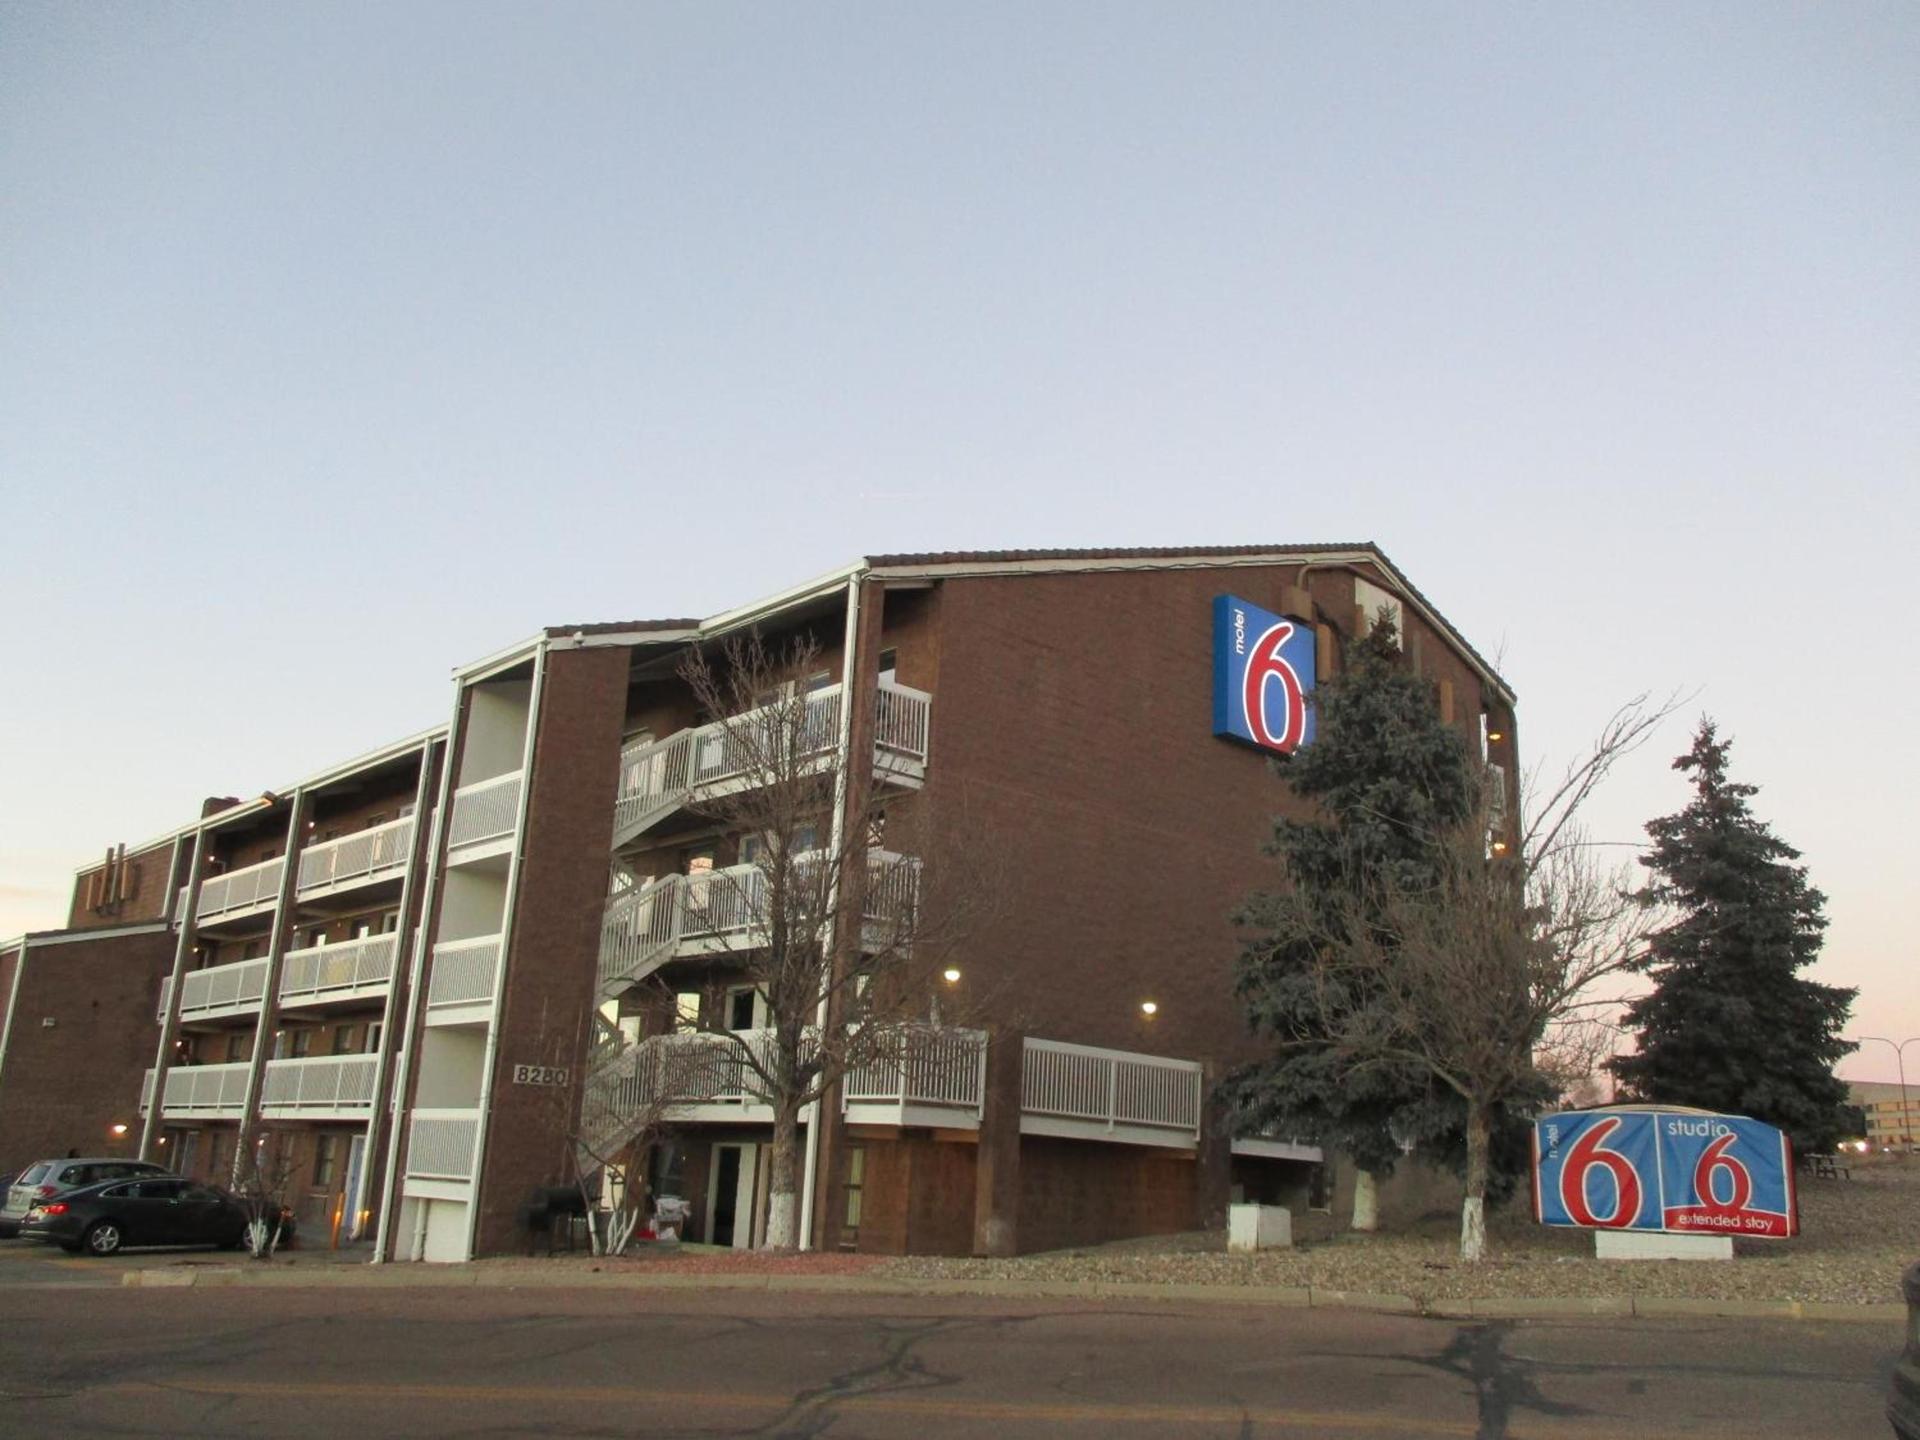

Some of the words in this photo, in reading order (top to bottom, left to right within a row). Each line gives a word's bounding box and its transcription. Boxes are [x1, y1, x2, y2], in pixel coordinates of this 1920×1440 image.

[1233, 609, 1245, 654] motel
[1243, 622, 1306, 757] 6
[1667, 1120, 1730, 1138] studio
[1560, 1116, 1642, 1228] 6
[1694, 1132, 1752, 1210] 6
[1678, 1214, 1741, 1228] extended
[1744, 1216, 1773, 1231] stay
